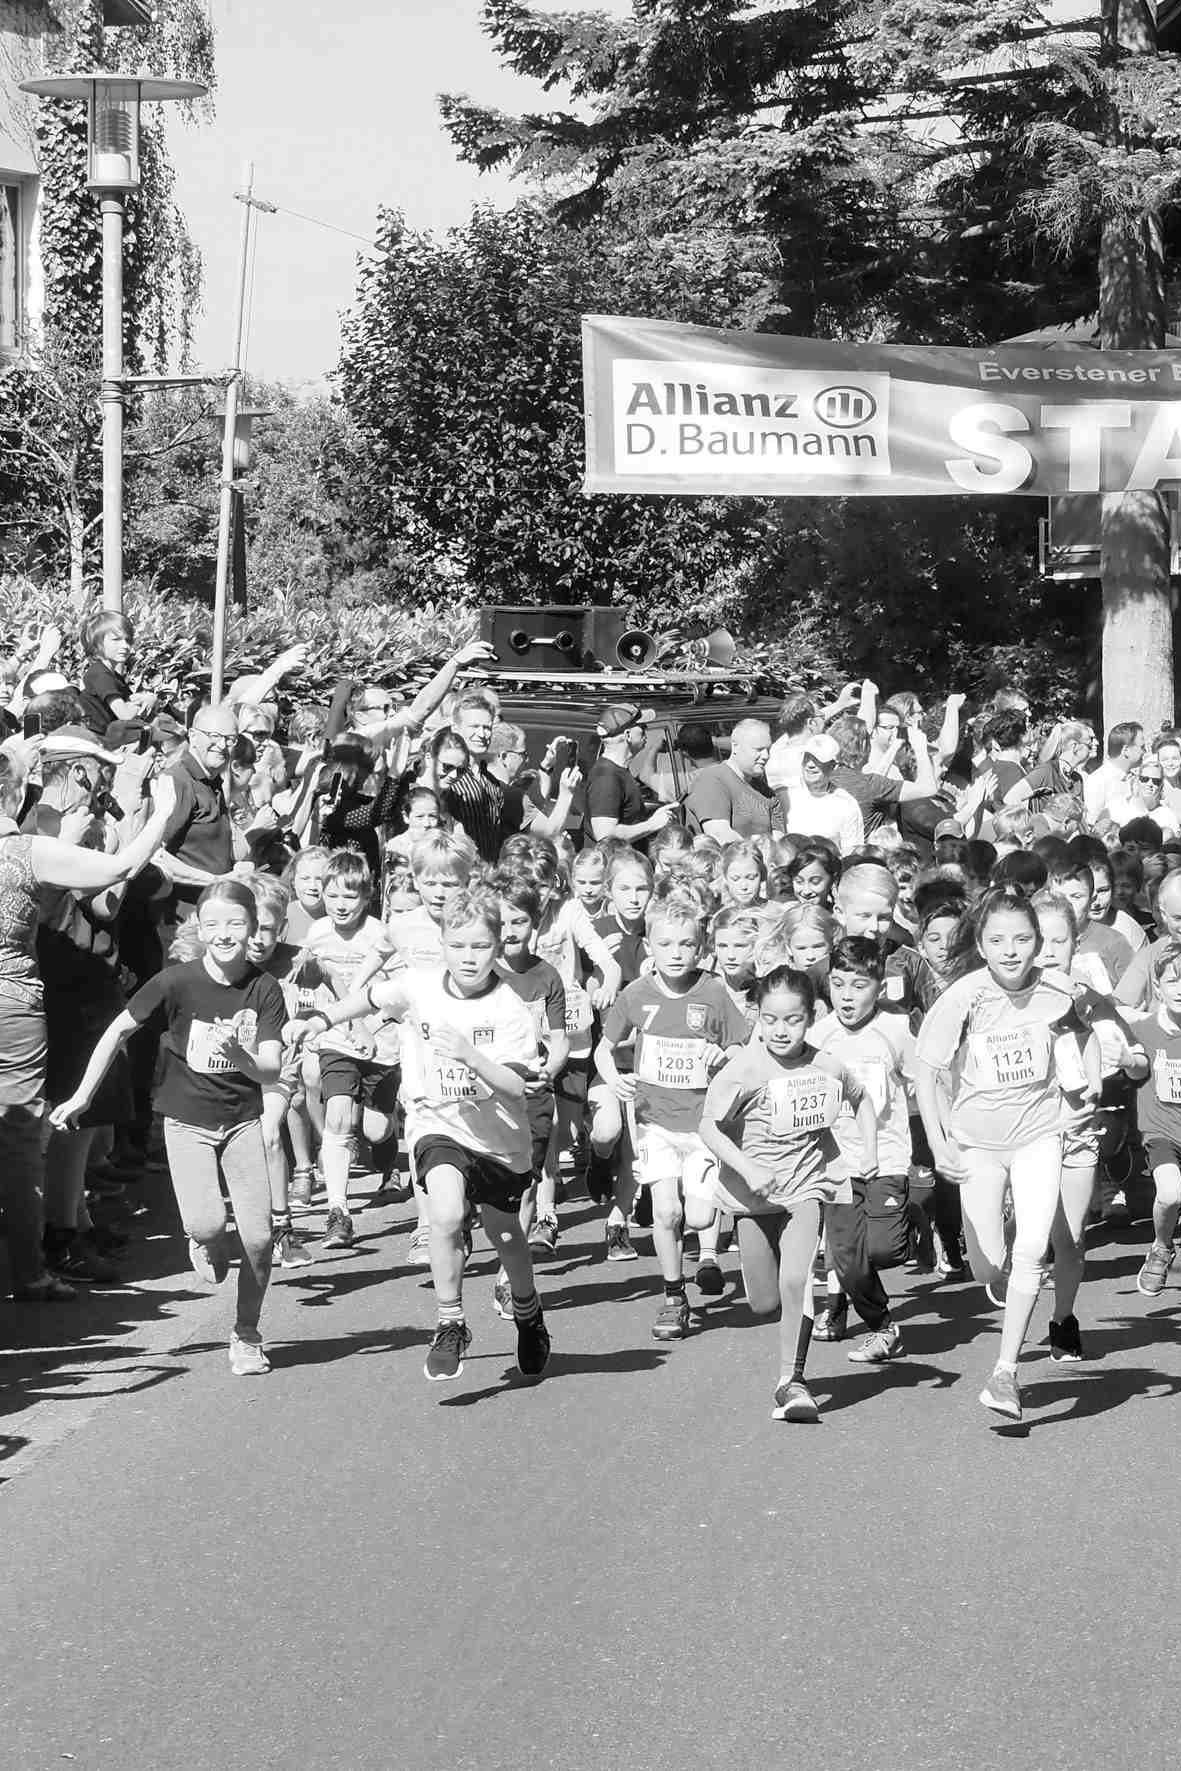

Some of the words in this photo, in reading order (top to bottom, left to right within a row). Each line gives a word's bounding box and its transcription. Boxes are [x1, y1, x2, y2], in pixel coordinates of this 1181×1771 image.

[977, 361, 1160, 383] Everstener
[625, 381, 800, 418] Allianz
[625, 422, 668, 457] D.
[678, 423, 878, 458] Baumann
[642, 1005, 661, 1031] 7
[658, 1055, 694, 1070] 1203
[992, 1047, 1032, 1068] 1121
[435, 1066, 477, 1081] 1475
[996, 1067, 1034, 1083] bruns
[791, 1093, 827, 1113] 1237
[793, 1112, 825, 1128] bruns
